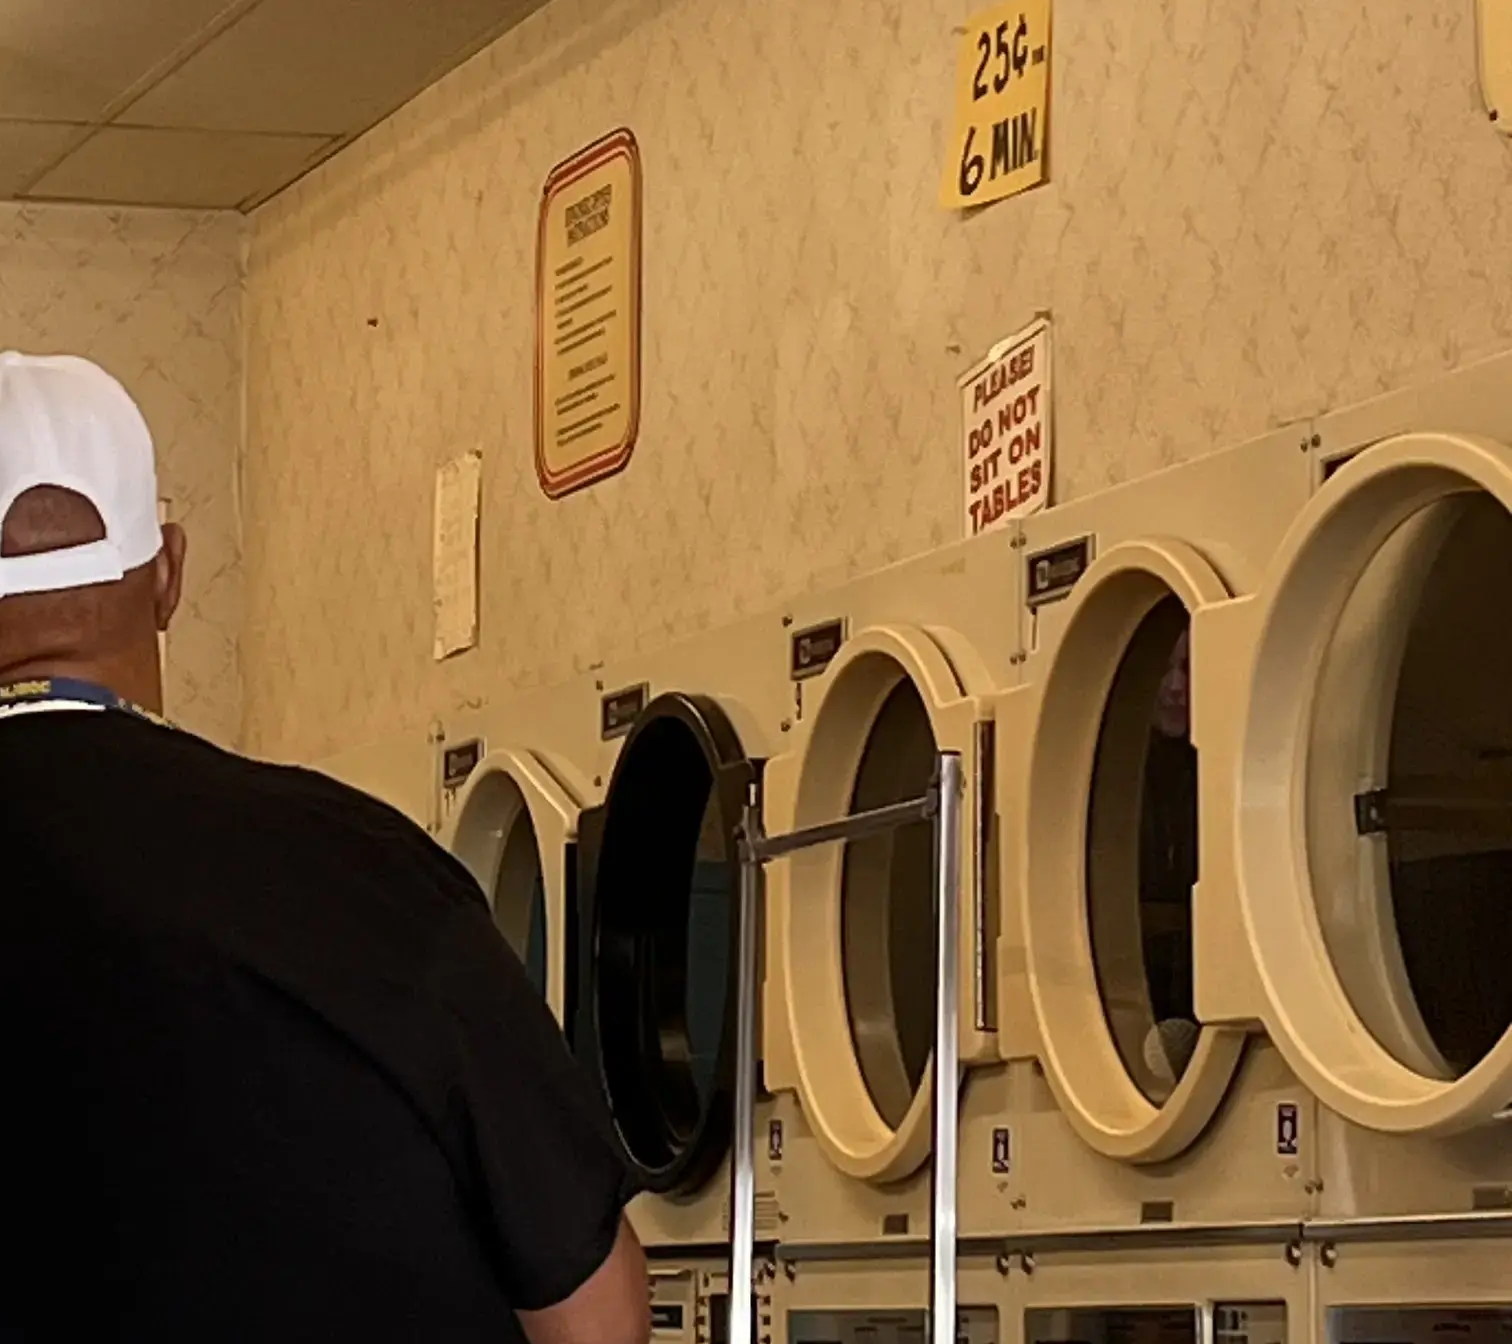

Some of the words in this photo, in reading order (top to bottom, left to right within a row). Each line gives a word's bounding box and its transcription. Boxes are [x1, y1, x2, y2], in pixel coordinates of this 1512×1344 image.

[973, 13, 1028, 102] 25¢
[959, 126, 985, 196] 6
[968, 419, 993, 459] DO
[998, 384, 1041, 436] NOT
[969, 448, 1002, 494] SIT
[1009, 422, 1041, 465] ON
[969, 459, 1042, 536] TABLES
